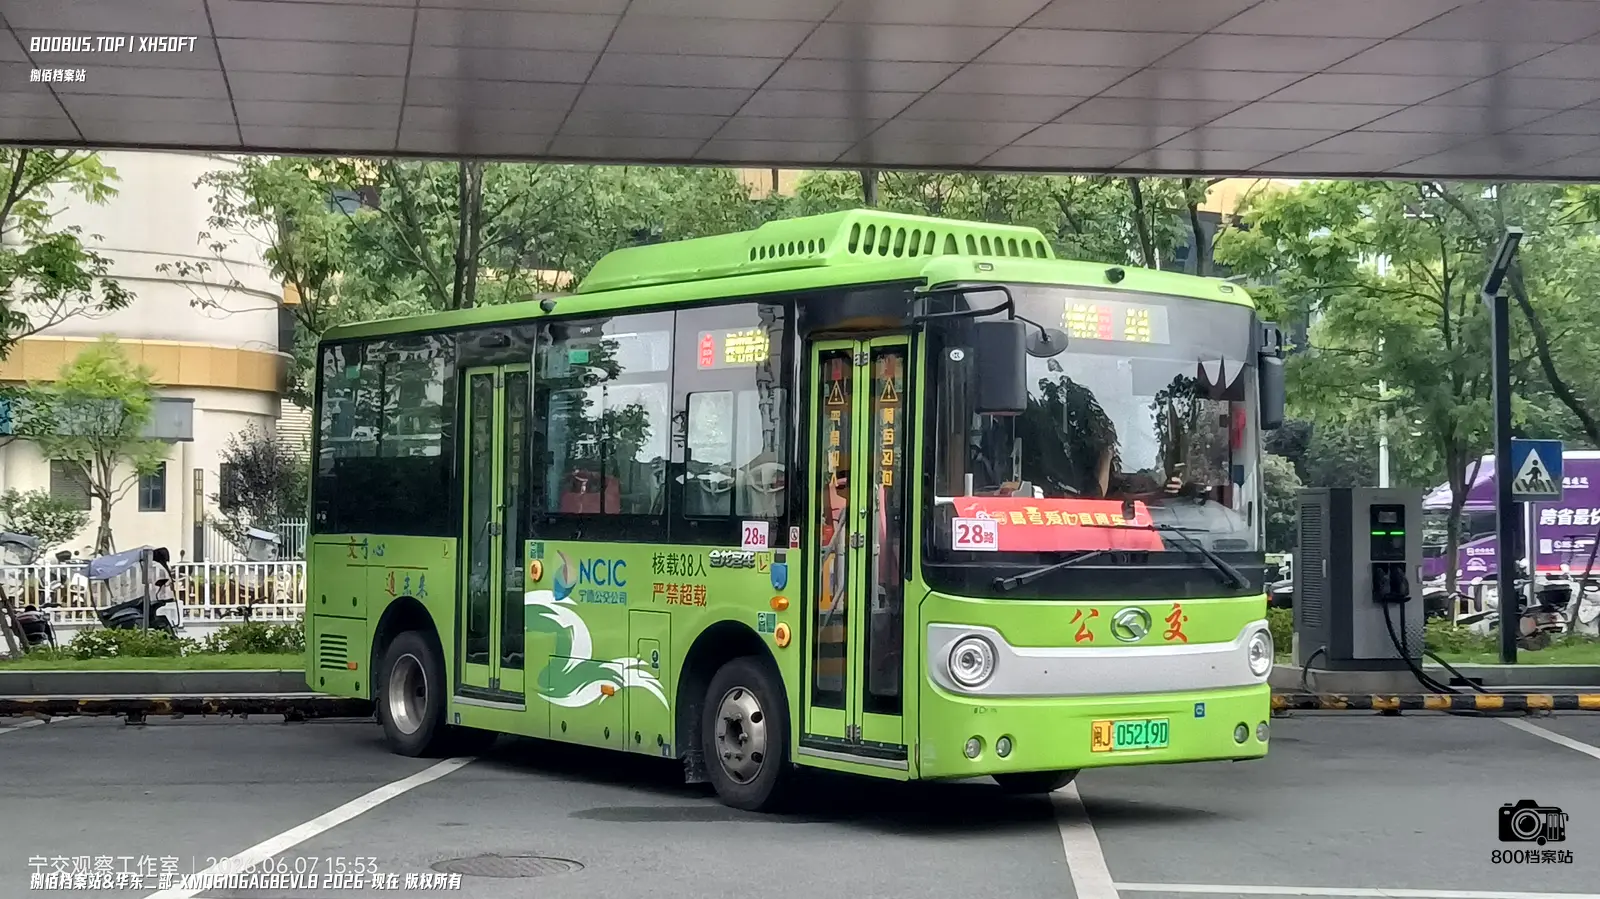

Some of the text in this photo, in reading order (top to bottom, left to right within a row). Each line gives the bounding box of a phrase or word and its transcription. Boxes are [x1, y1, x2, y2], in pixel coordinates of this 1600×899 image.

[579, 558, 627, 588] NCIC
[651, 552, 708, 578] 核载38人
[651, 582, 708, 608] 严禁超载
